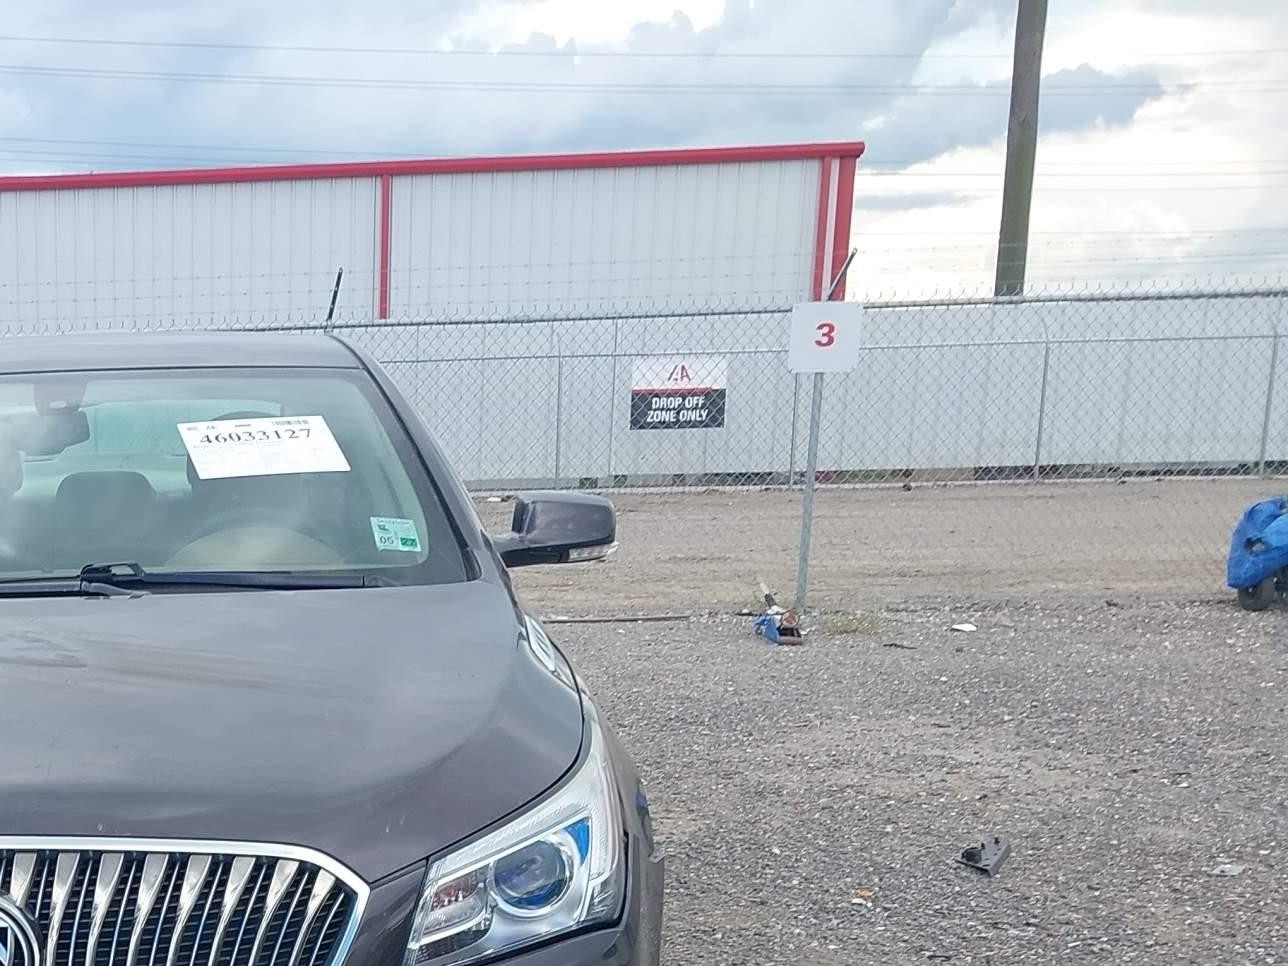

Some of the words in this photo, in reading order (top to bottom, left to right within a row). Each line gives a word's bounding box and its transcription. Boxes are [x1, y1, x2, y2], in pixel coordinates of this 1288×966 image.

[815, 323, 835, 347] 3
[652, 397, 682, 409] DROP
[685, 396, 705, 408] OFF
[647, 410, 677, 422] ZONE
[679, 409, 708, 421] ONLY
[200, 428, 311, 443] 46033127
